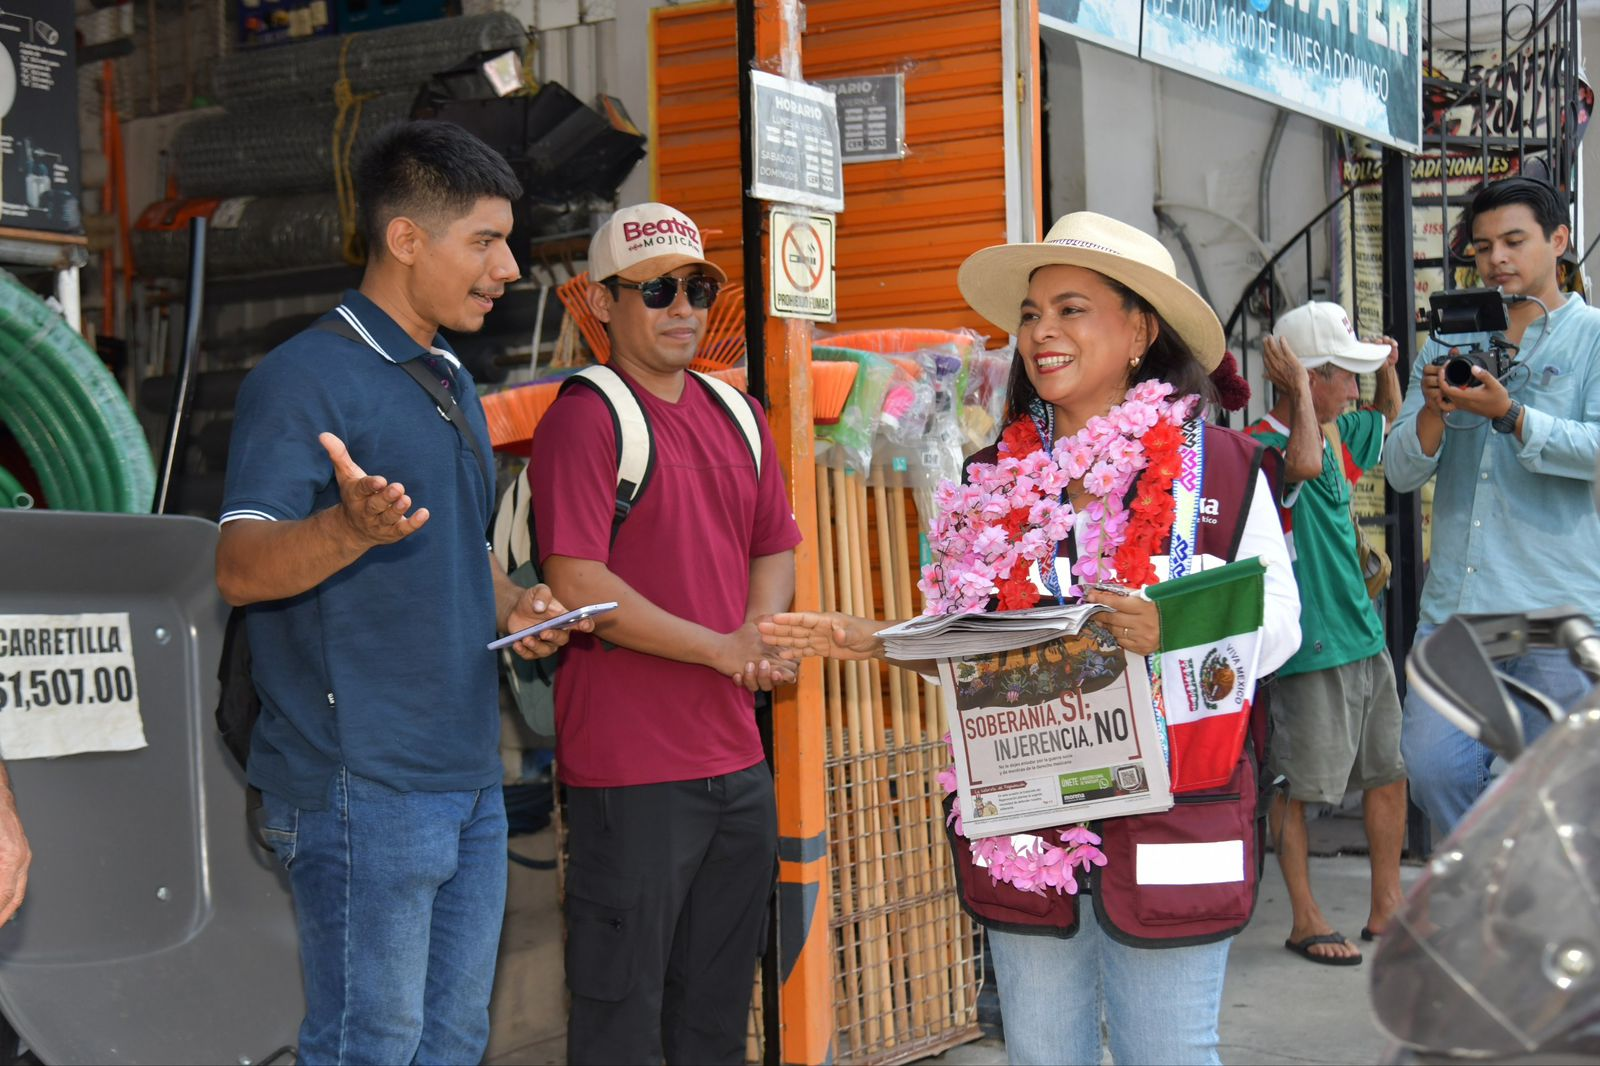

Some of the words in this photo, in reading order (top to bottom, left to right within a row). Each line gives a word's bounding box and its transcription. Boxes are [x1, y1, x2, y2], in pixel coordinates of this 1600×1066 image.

[1208, 0, 1219, 37] A
[1222, 4, 1256, 50] 10:00
[1258, 17, 1277, 58] DE
[1280, 27, 1321, 75] LUNES
[1323, 45, 1332, 80] A
[1333, 48, 1389, 102] DOMINGO
[775, 95, 823, 120] HORARIO
[624, 217, 699, 244] Beatriz
[643, 235, 693, 248] MOJICA
[0, 626, 122, 657] CARRETILLA
[1226, 644, 1240, 665] VIVA
[1234, 666, 1245, 705] MEXICO
[1060, 679, 1092, 722] SÍ;
[994, 725, 1093, 761] INJERENCIA,
[1094, 707, 1128, 744] NO
